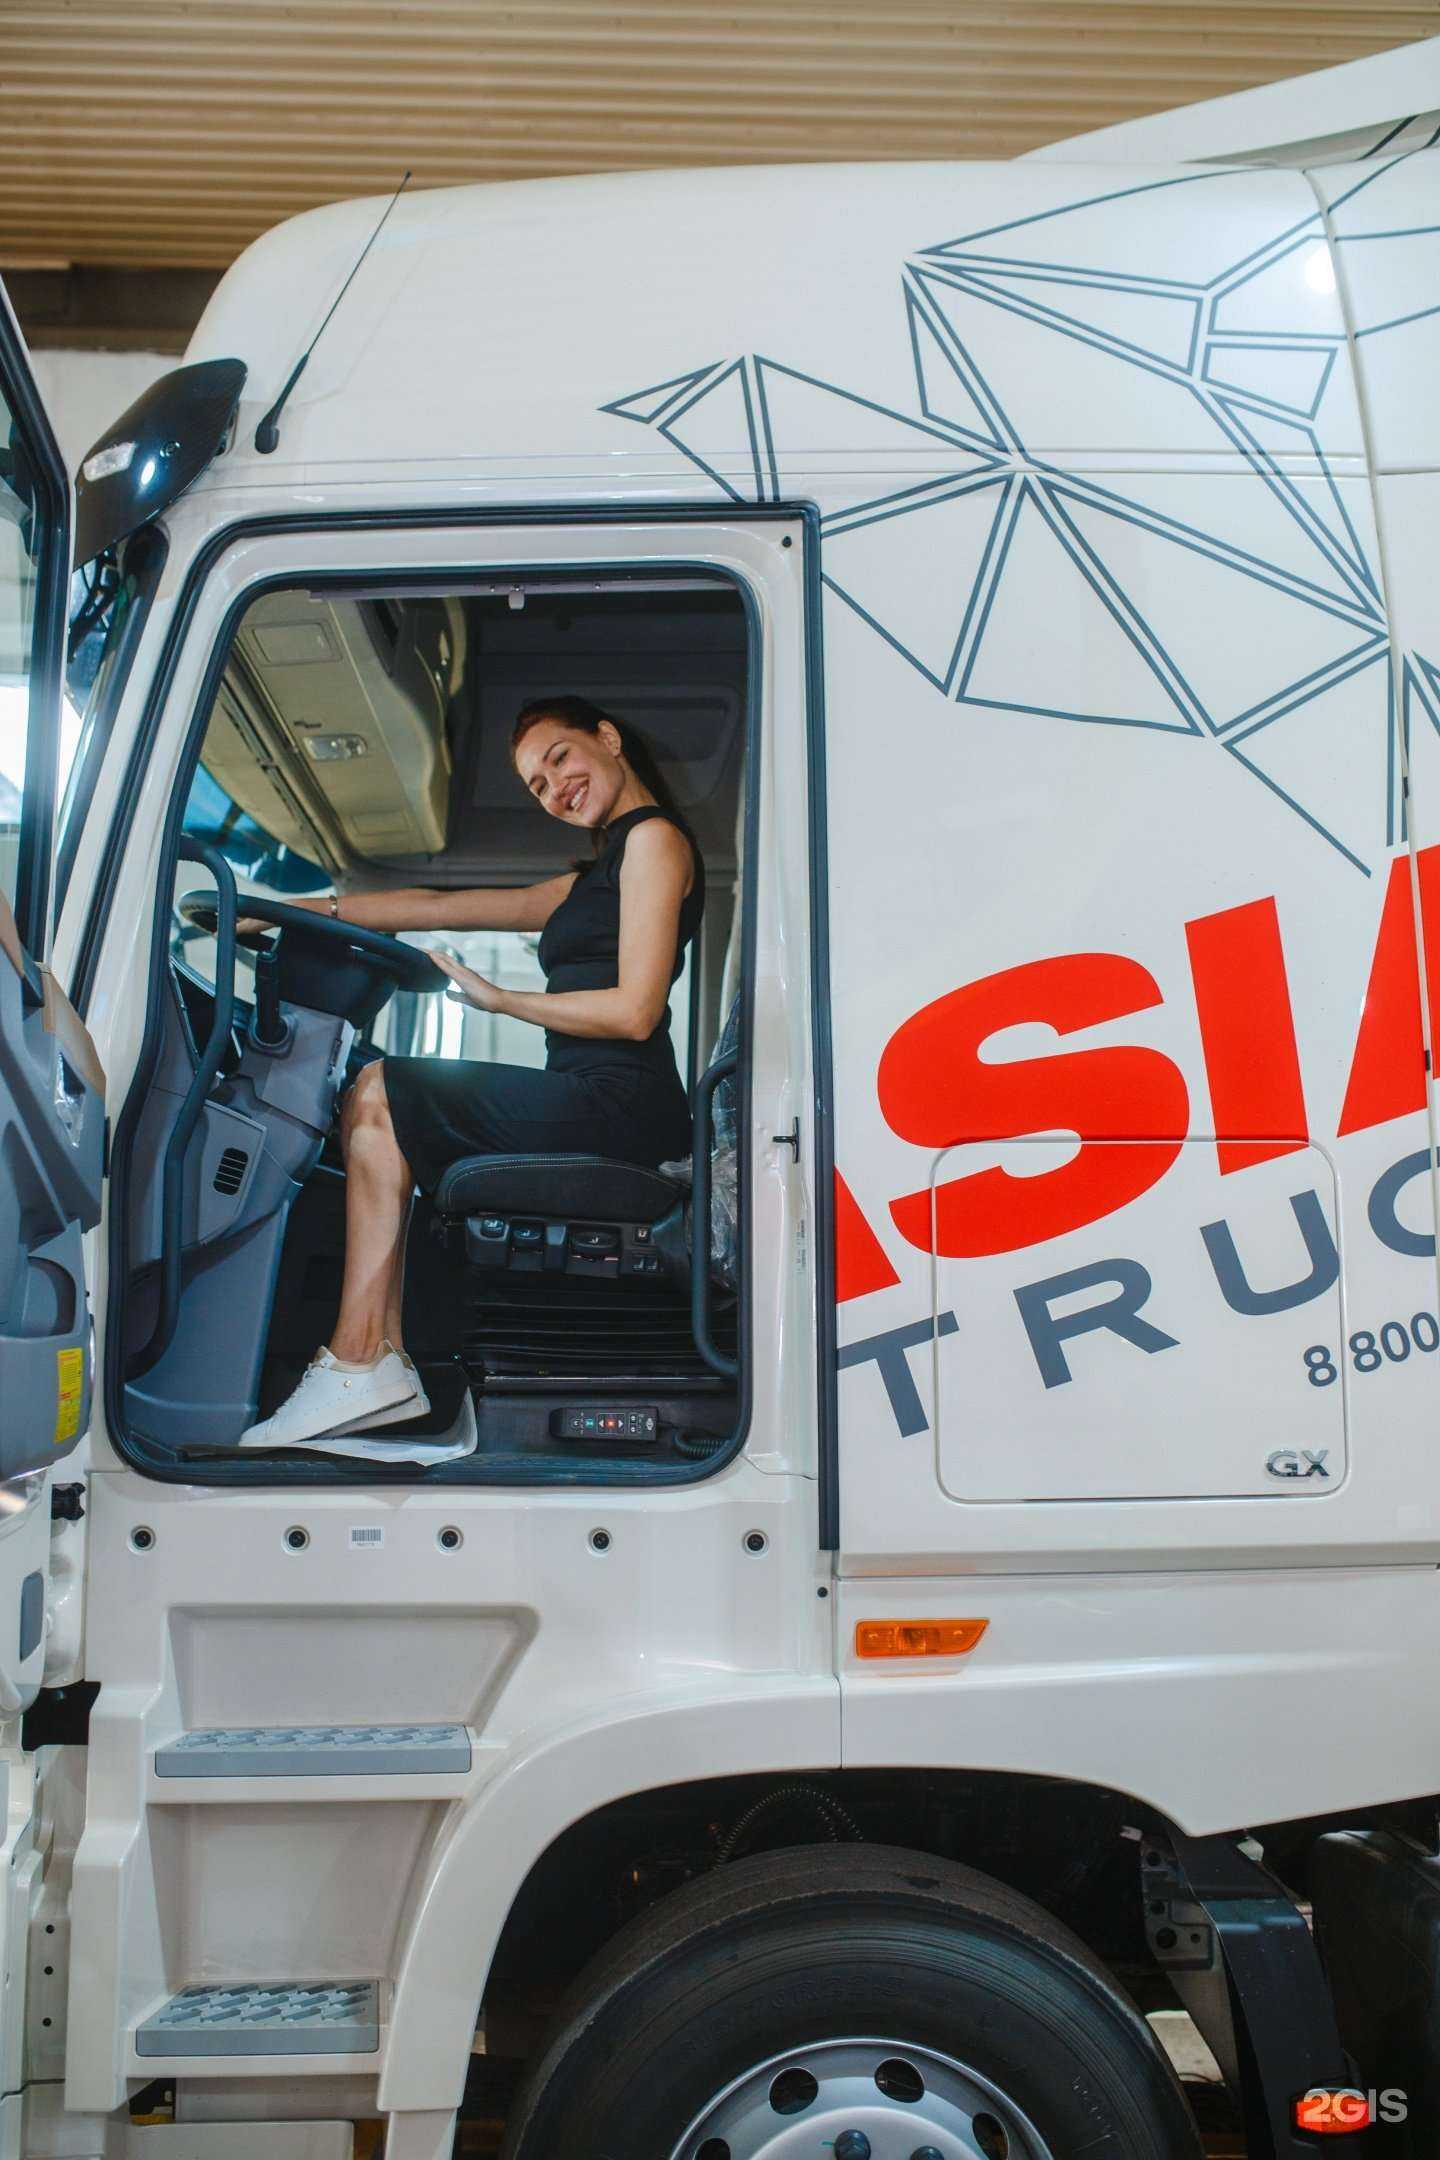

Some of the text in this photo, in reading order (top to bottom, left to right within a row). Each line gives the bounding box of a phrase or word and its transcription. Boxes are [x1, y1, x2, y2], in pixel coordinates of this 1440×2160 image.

[1303, 1311, 1440, 1387] 8 800
[1266, 1449, 1329, 1478] GX
